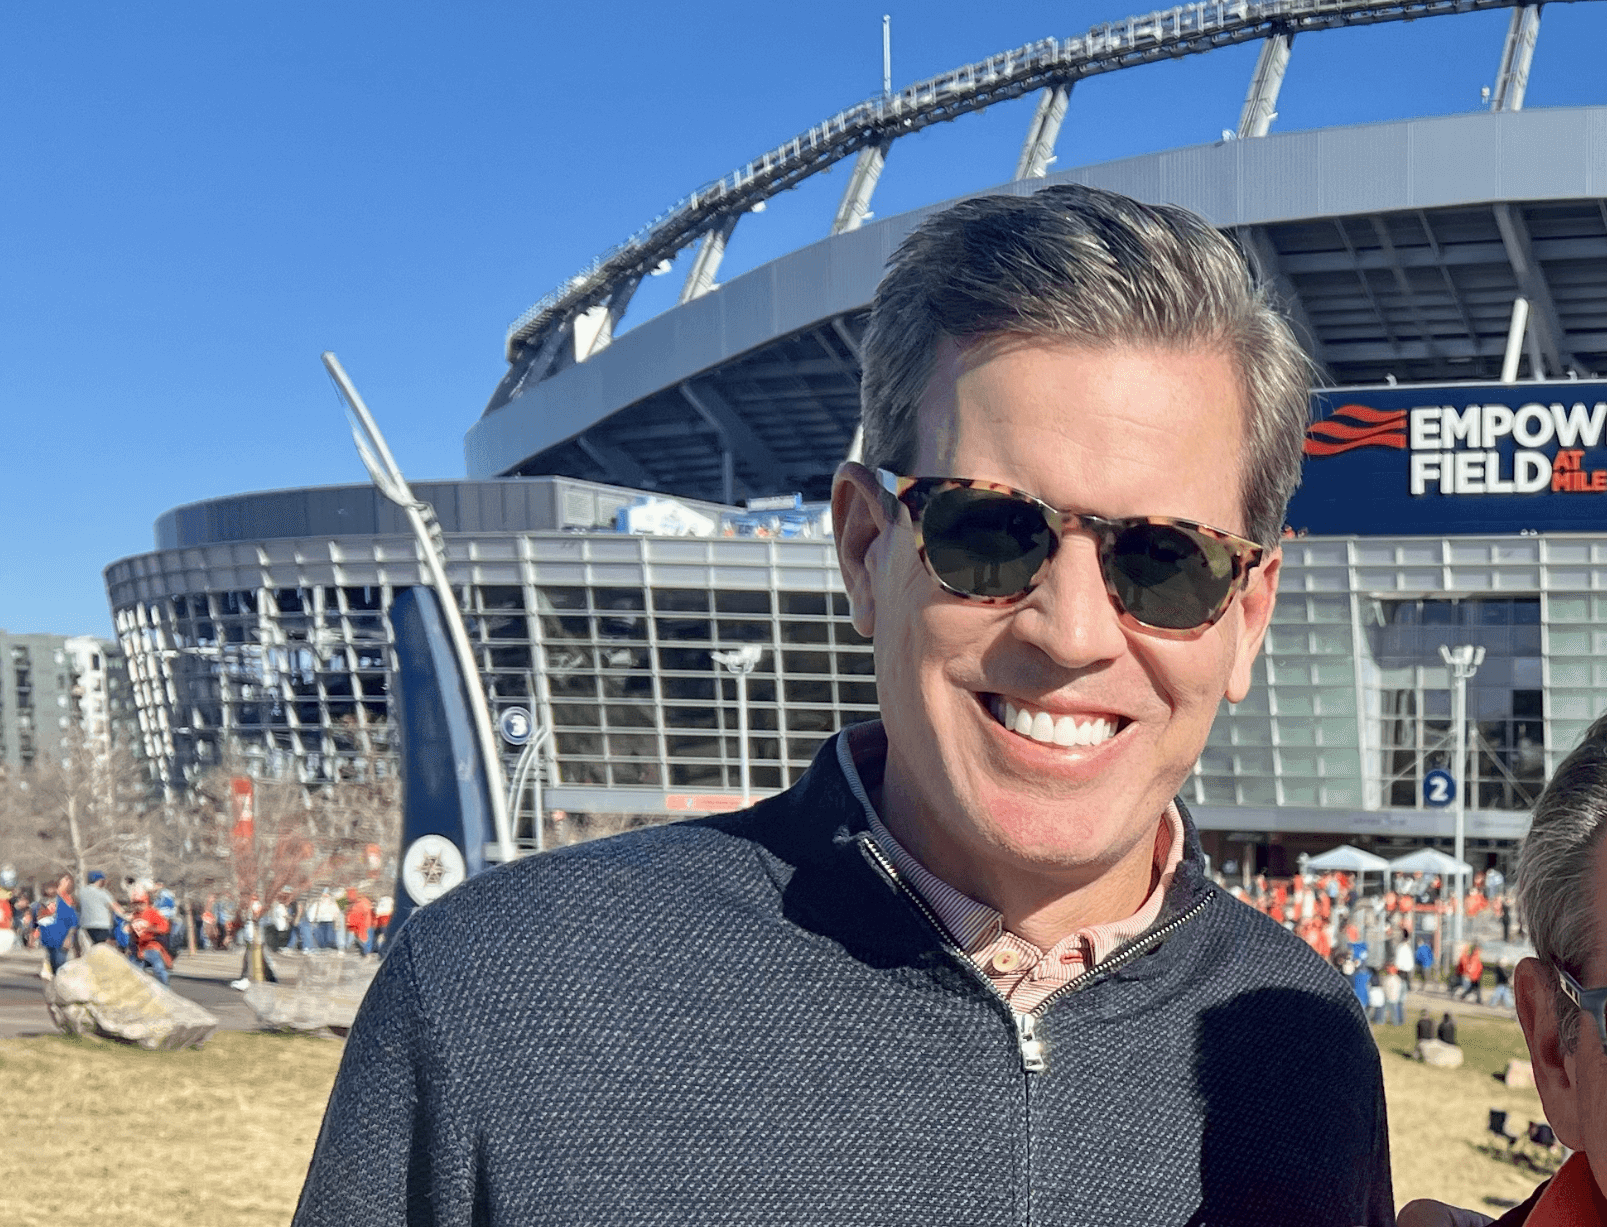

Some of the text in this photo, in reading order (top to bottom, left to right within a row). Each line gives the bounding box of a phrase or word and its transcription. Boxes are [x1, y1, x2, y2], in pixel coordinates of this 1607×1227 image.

[1553, 449, 1585, 470] AT
[1410, 450, 1552, 494] FIELD
[510, 714, 527, 737] 3
[1429, 776, 1449, 802] 2
